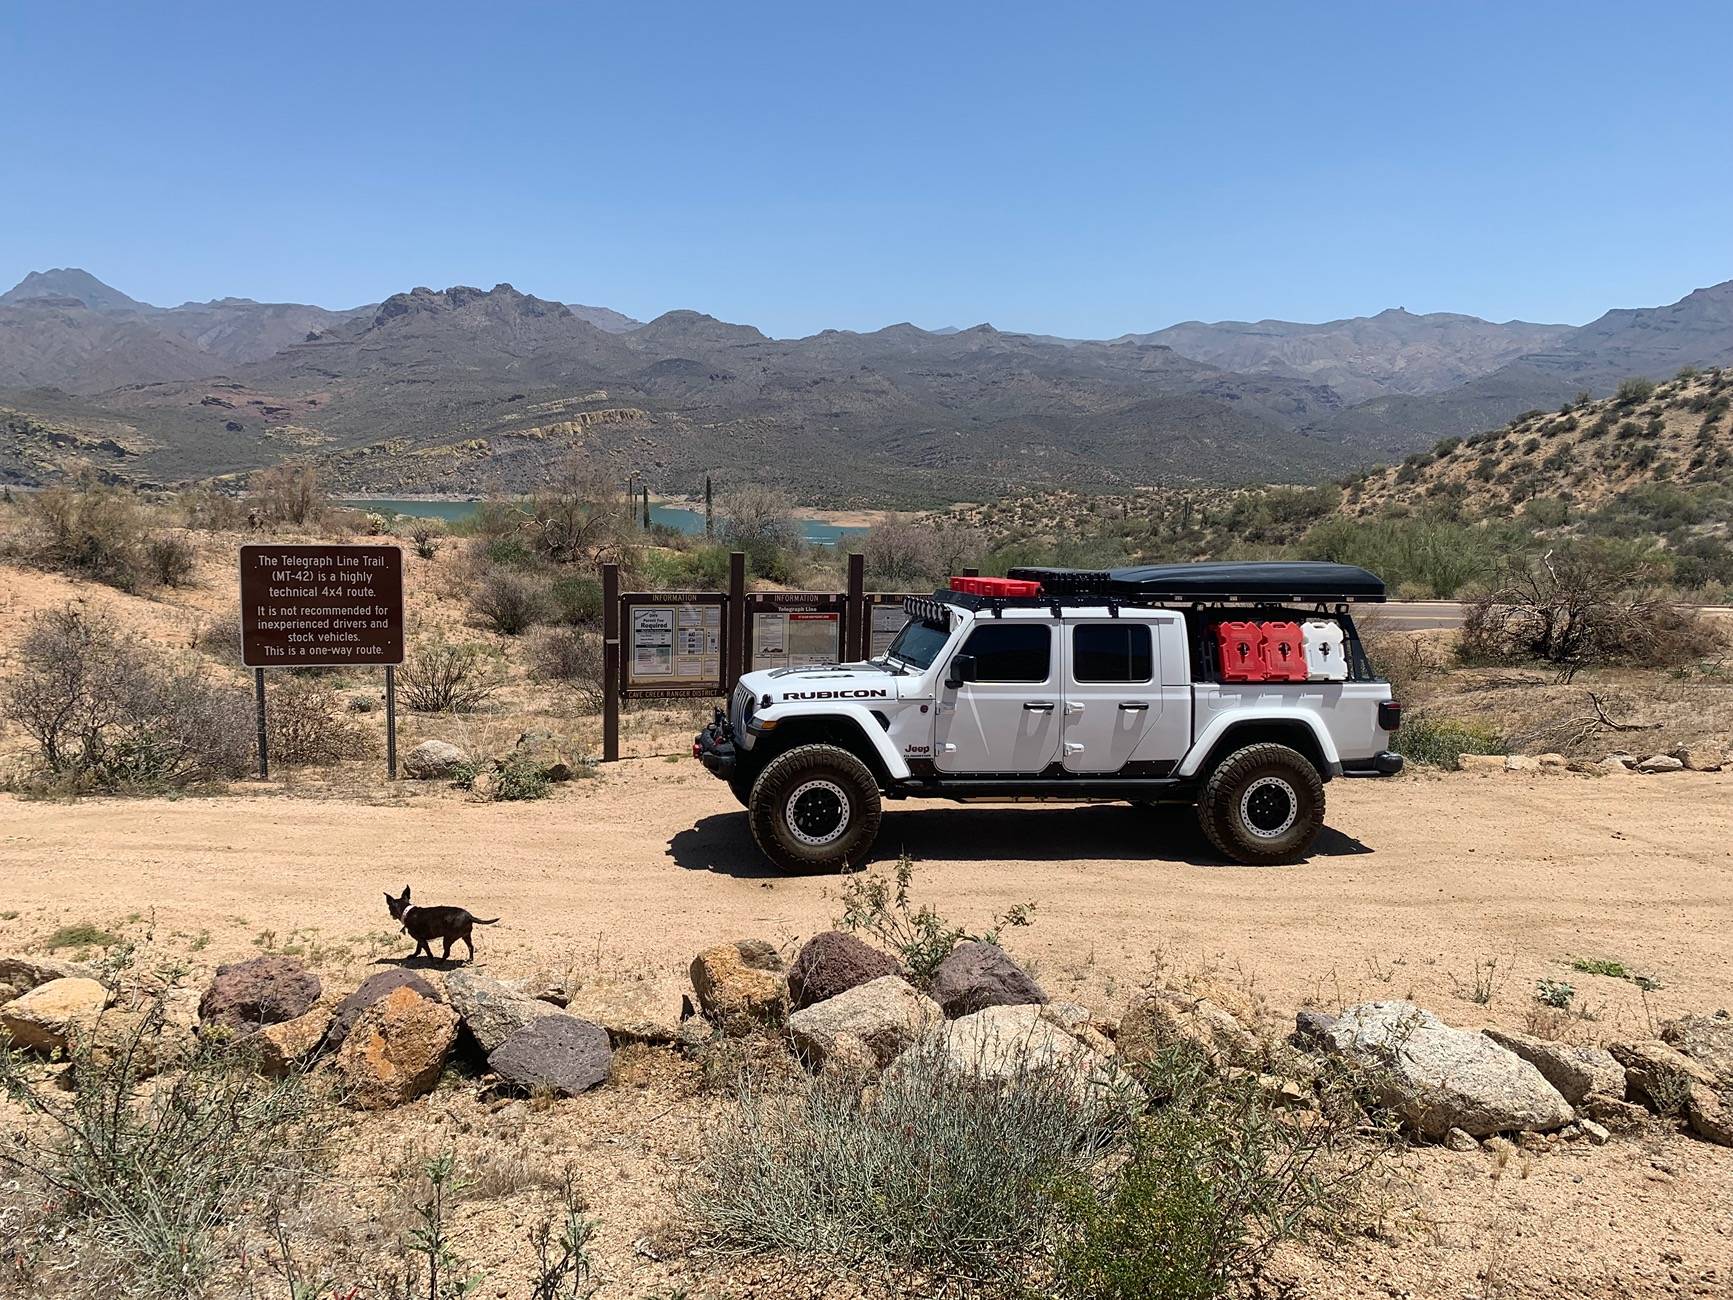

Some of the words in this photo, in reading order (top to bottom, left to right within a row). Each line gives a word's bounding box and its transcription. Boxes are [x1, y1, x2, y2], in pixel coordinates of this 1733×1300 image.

[258, 555, 278, 566] The
[281, 555, 333, 569] Telegraph
[336, 556, 359, 566] Line
[362, 555, 385, 567] Trail
[272, 571, 314, 582] (MT-42)
[318, 571, 326, 582] is
[330, 573, 336, 582] a
[340, 571, 373, 584] highly
[269, 586, 318, 597] technical
[321, 586, 343, 597] 4x4
[347, 586, 376, 597] route.
[652, 594, 697, 602] INFORMATION
[774, 594, 819, 602] INFORMATION
[257, 605, 265, 616] It
[268, 605, 277, 616] is
[280, 606, 297, 616] not
[300, 605, 371, 616] recommended
[375, 605, 388, 616] for
[257, 619, 329, 631] inexperienced
[333, 618, 367, 629] drivers
[370, 618, 389, 629] and
[640, 622, 668, 630] Required
[287, 631, 314, 642] stock
[318, 631, 361, 642] vehicles.
[264, 645, 285, 656] This
[288, 645, 296, 656] is
[299, 648, 306, 656] a
[309, 647, 353, 657] one-way
[356, 645, 384, 655] route.
[628, 691, 643, 699] CAVE
[666, 690, 691, 698] RANGER
[692, 689, 718, 697] DISTRICT
[783, 689, 887, 701] RUBICON
[904, 744, 930, 754] Jeep
